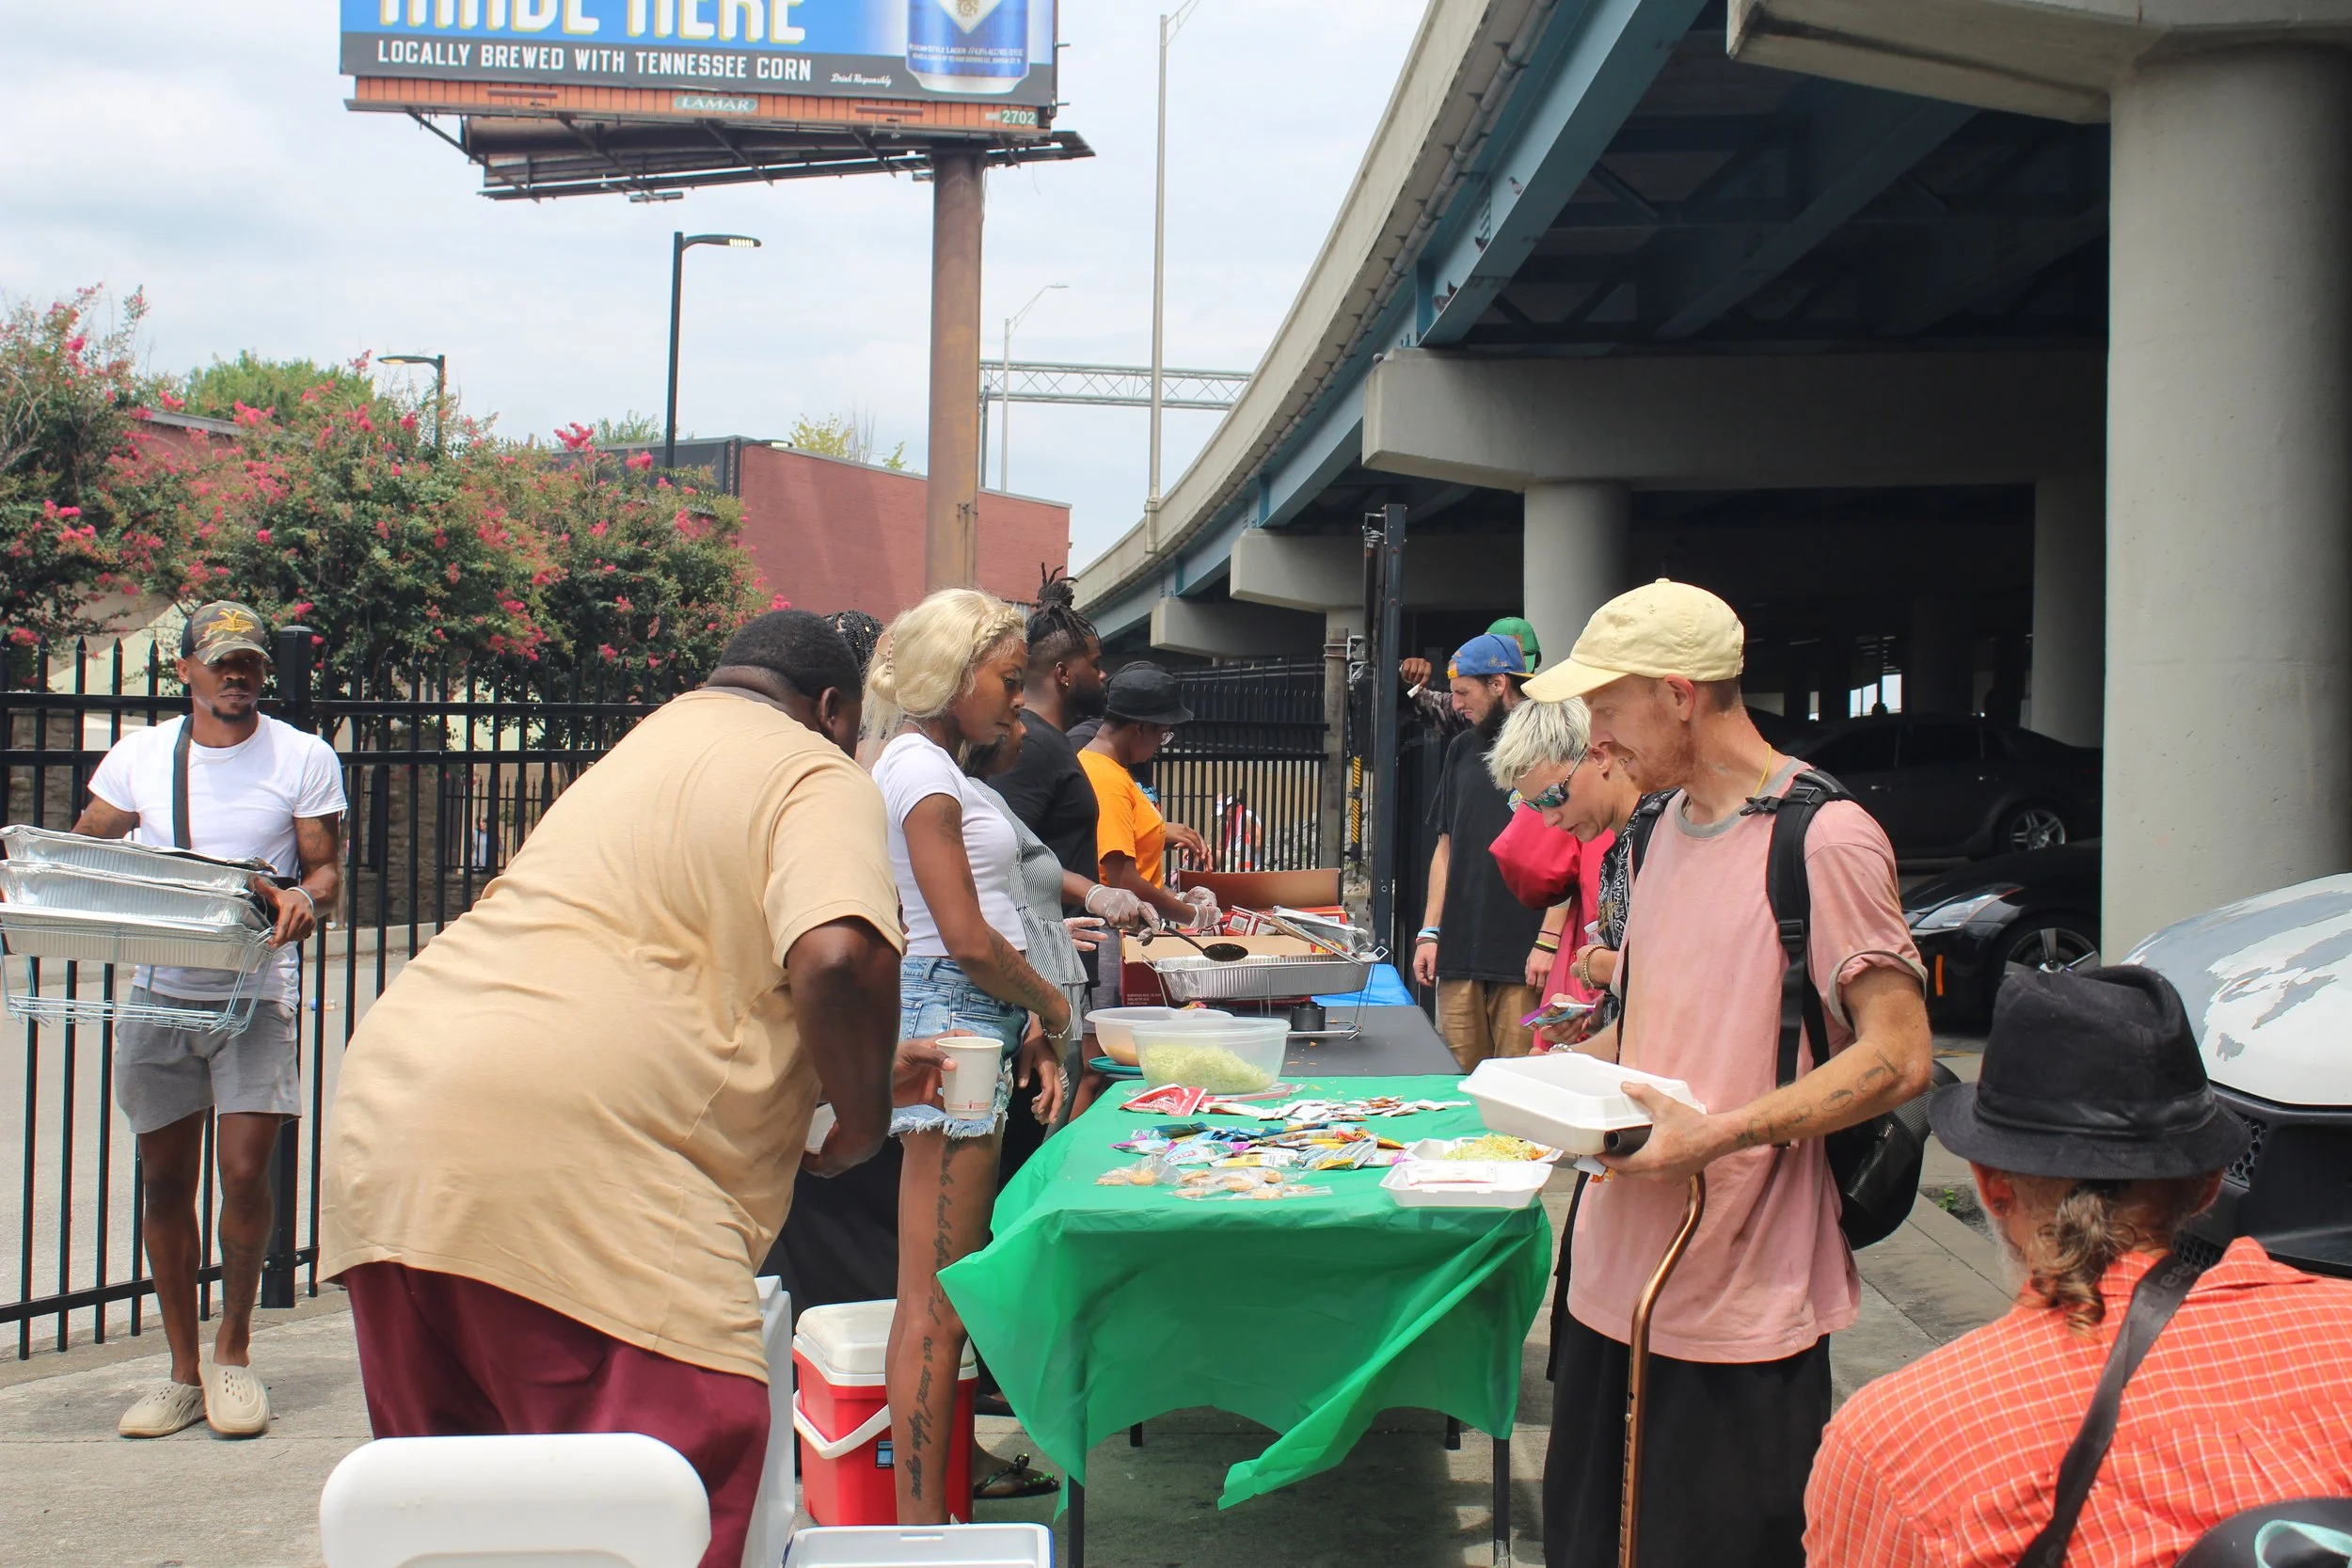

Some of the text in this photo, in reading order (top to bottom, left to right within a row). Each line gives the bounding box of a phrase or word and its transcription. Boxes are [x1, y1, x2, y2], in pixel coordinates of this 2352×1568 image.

[378, 40, 811, 82] LOCALLY BREWED WITH TENNESSEE CORN
[831, 72, 852, 84] Drink
[682, 97, 749, 111] LAMAR
[1001, 109, 1036, 125] 2702
